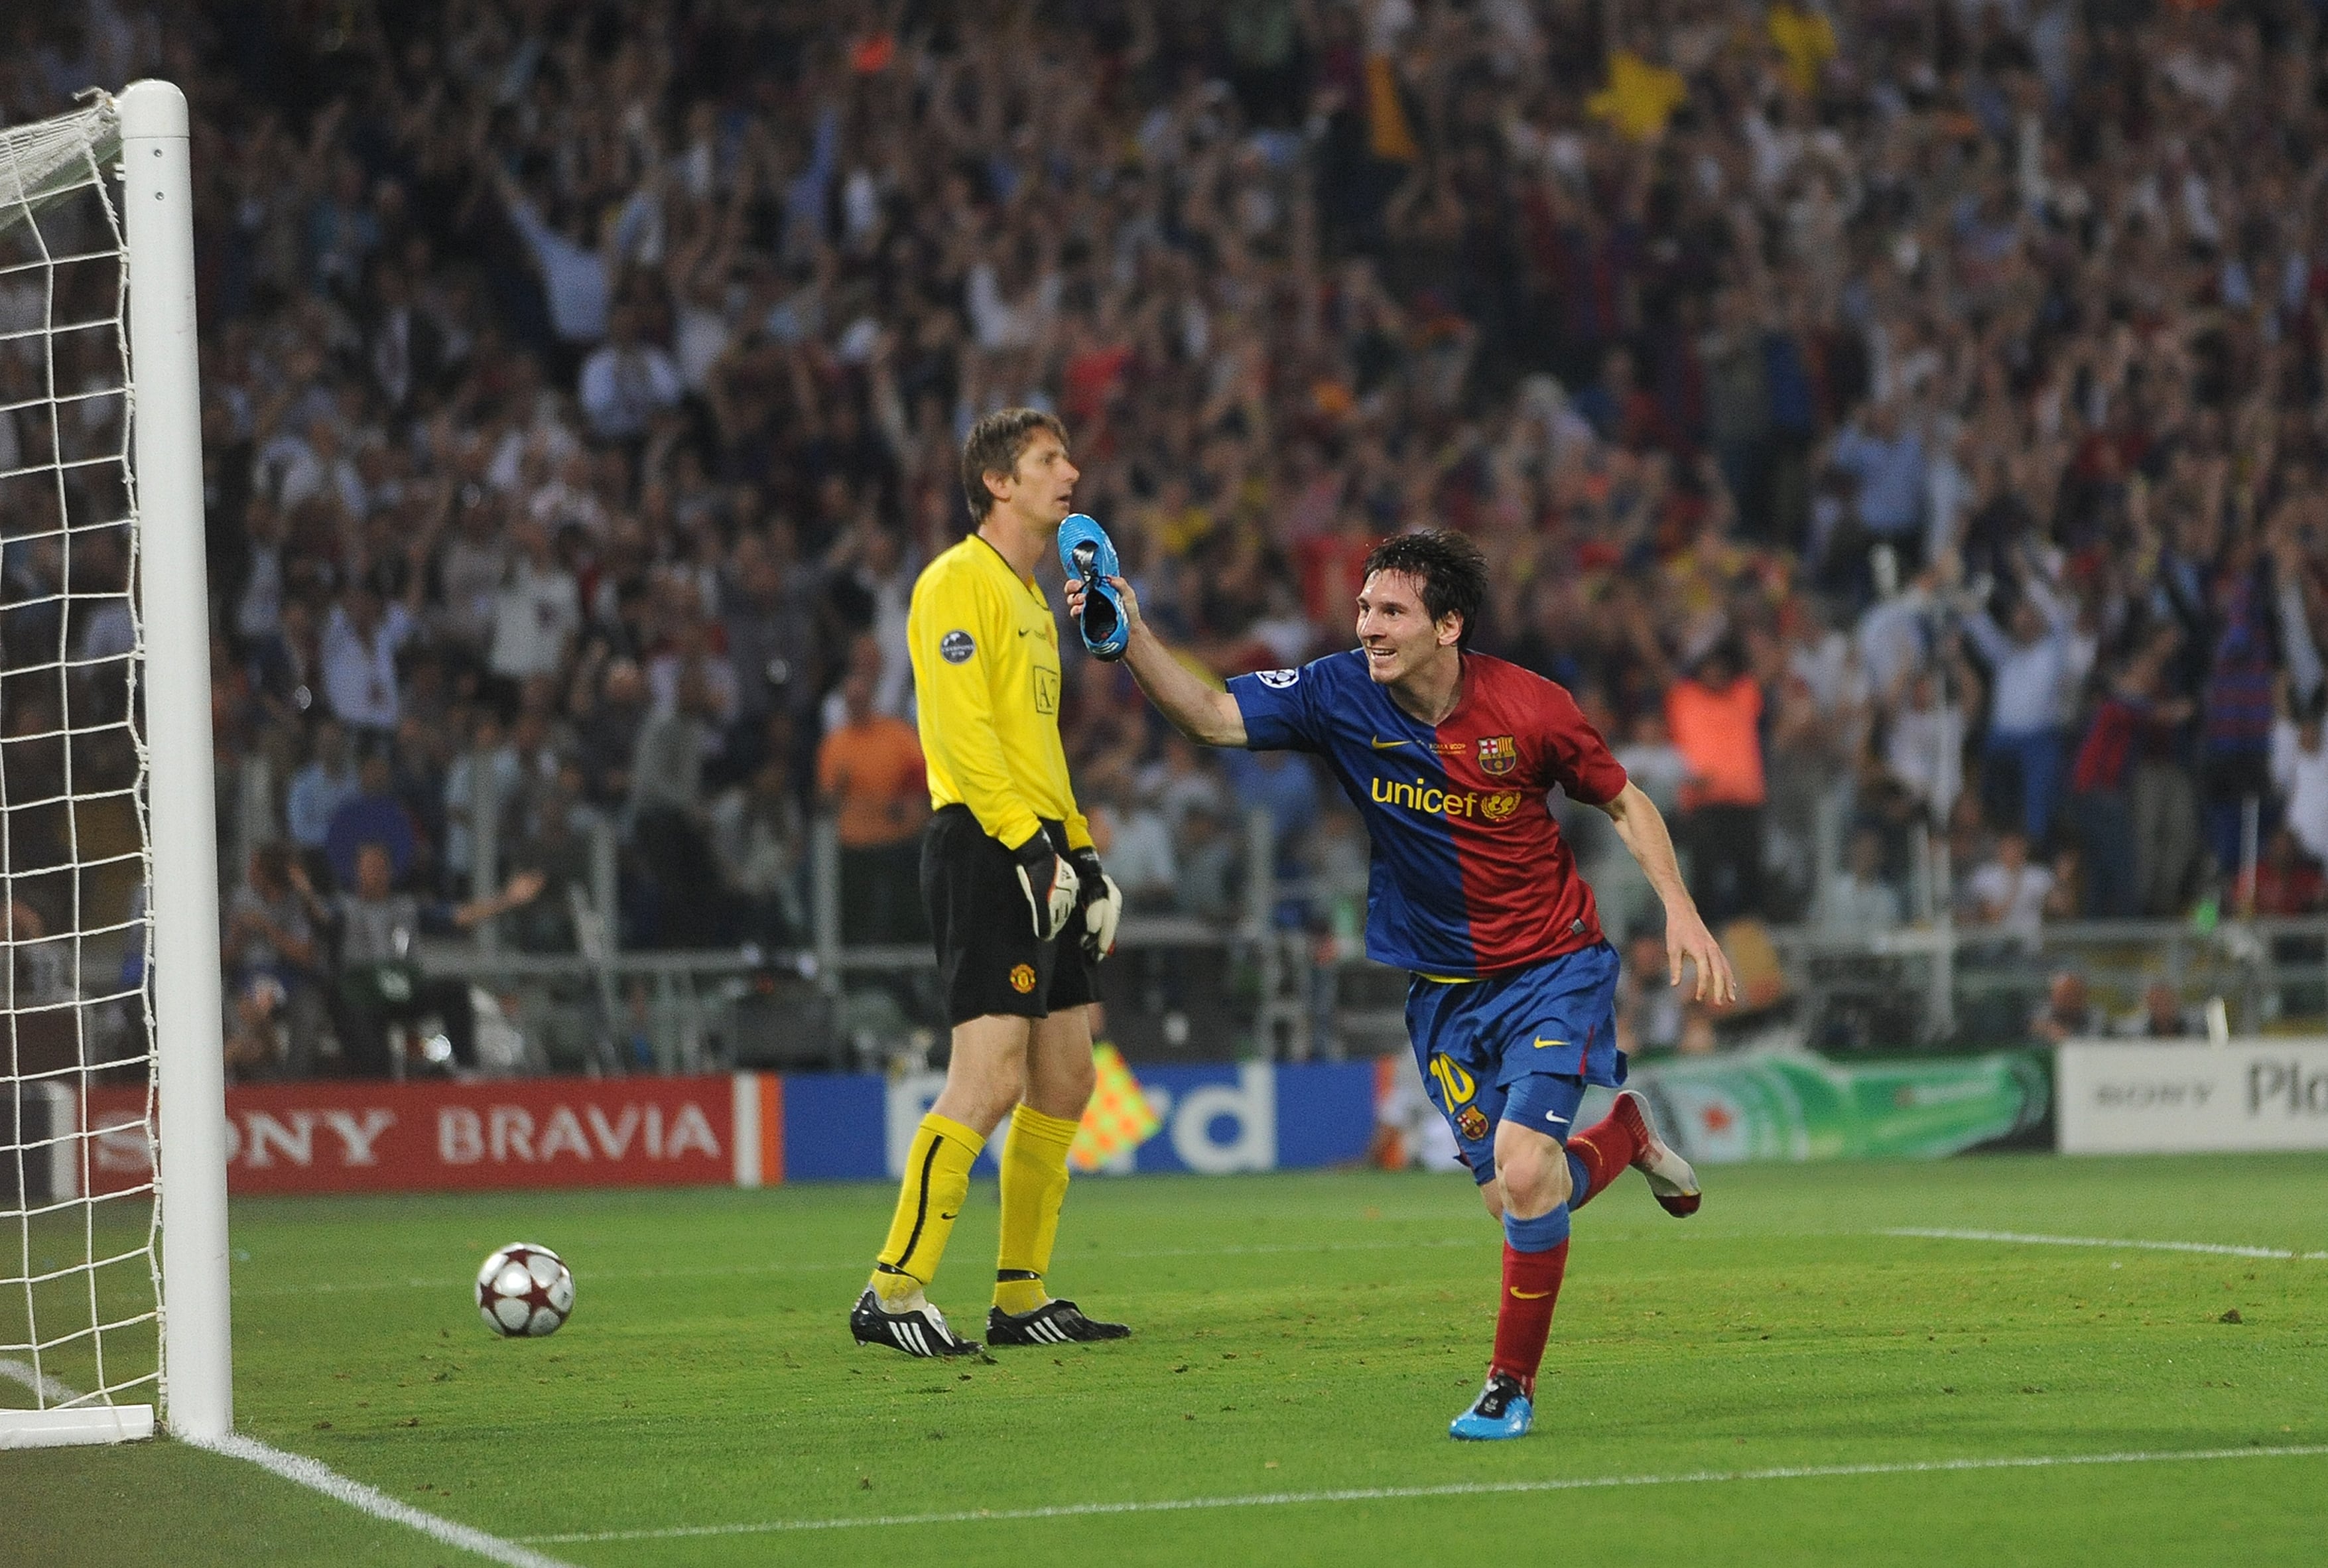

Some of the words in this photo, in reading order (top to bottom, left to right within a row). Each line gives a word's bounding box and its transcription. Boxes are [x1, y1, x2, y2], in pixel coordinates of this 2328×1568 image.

[1372, 777, 1478, 817] unicef
[1429, 1052, 1476, 1114] 10
[98, 1108, 394, 1171] SNY
[438, 1102, 722, 1164] BRAVIA
